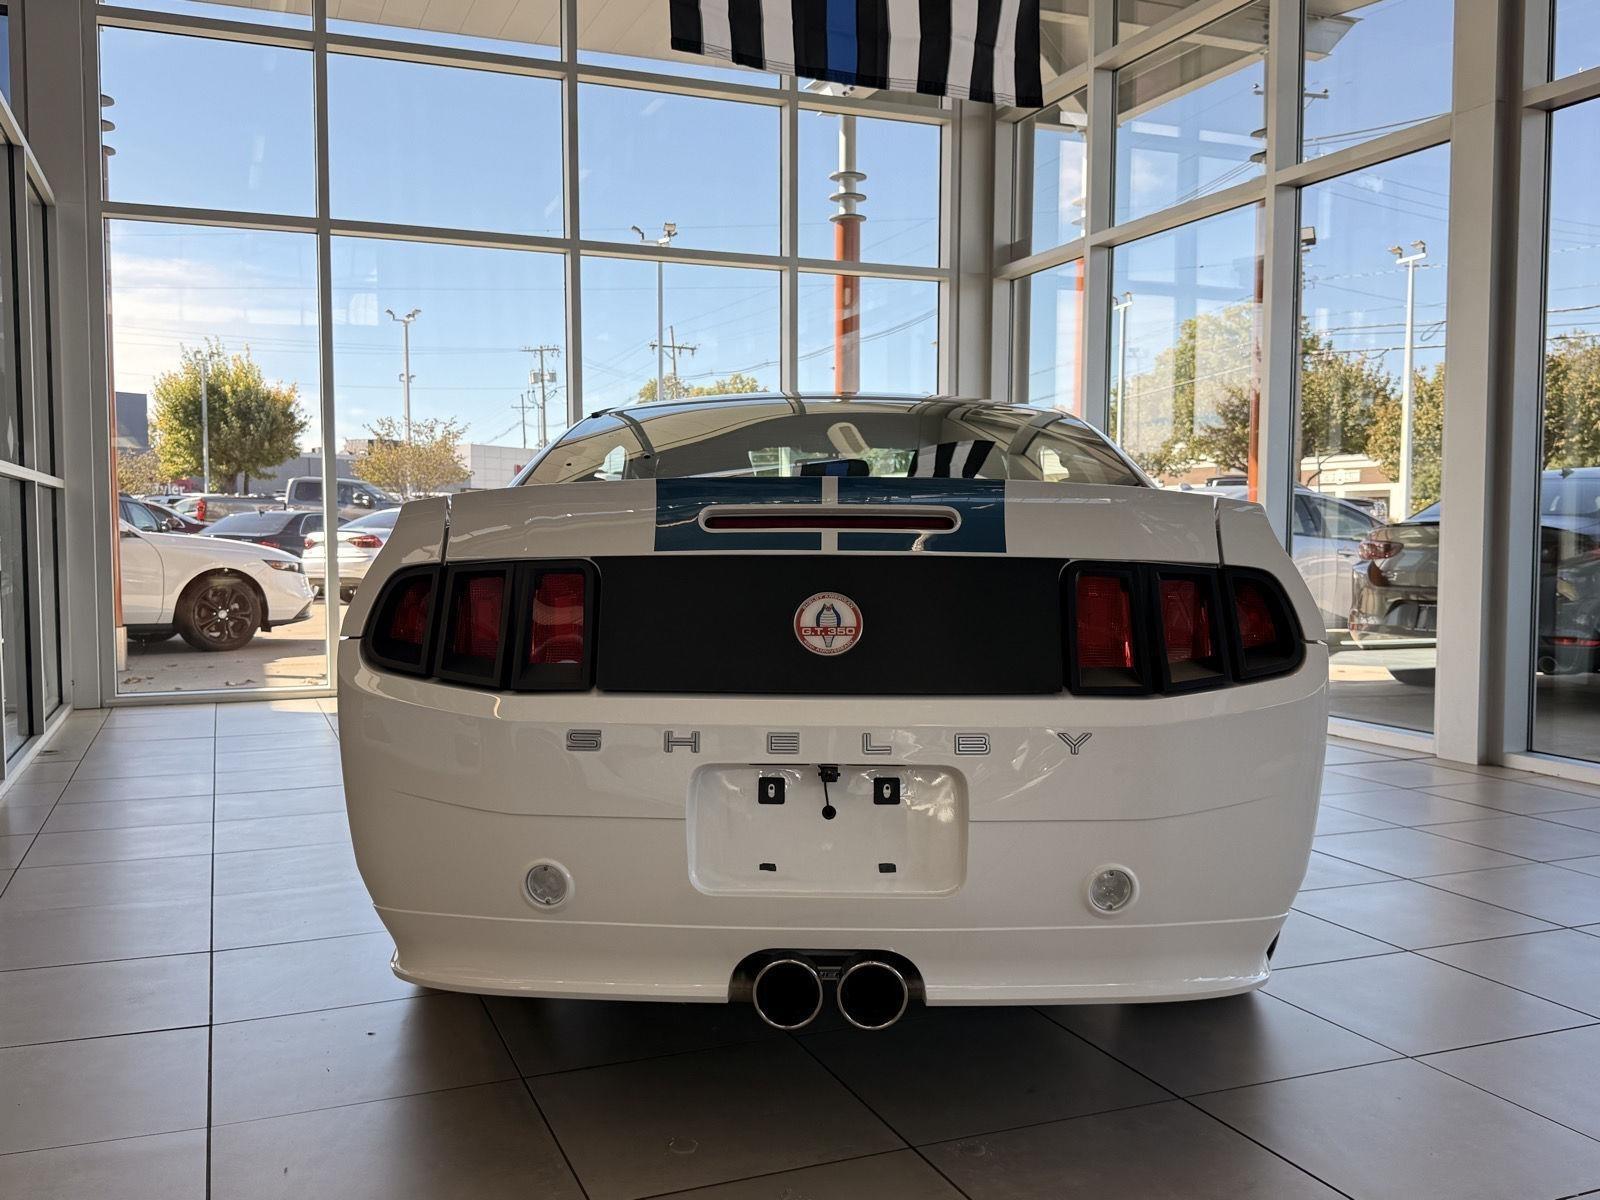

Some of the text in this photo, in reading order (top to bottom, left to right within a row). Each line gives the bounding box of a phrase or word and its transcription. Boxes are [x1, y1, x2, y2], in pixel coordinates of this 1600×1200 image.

[802, 627, 856, 635] G.T. 350
[566, 729, 1092, 755] SHELBY
